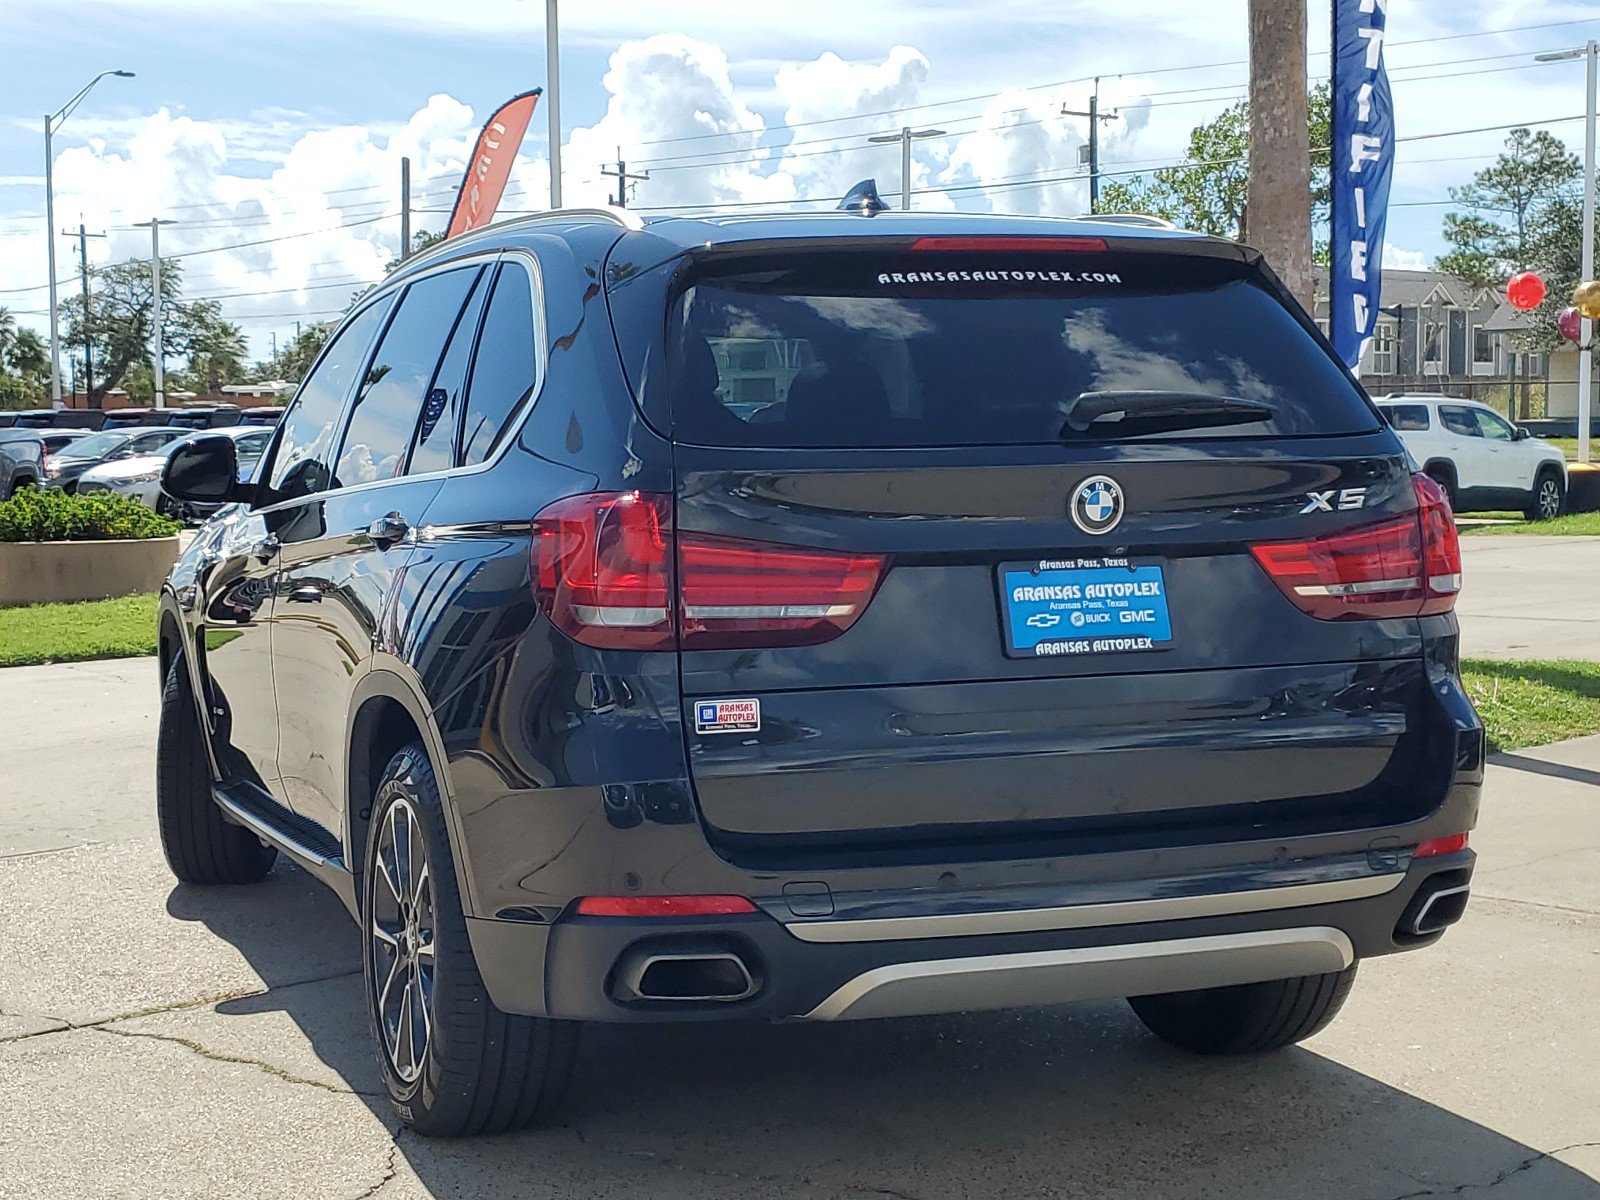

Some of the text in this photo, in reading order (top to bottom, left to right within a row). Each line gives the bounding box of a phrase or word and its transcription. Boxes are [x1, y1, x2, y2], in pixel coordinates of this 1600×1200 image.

[1350, 0, 1386, 333] TIFIED
[878, 271, 1122, 283] ARANSASAUTOPLEX.COM
[1081, 482, 1118, 498] BMW
[1299, 487, 1367, 514] X5
[1039, 557, 1128, 570] Aransas Pass, Texas
[1013, 582, 1160, 602] ARANSAS AUTOPLEX
[1049, 599, 1129, 610] Aransas Pass, Texas
[1086, 613, 1111, 622] BUICK
[1119, 610, 1155, 622] GMC
[1035, 637, 1153, 656] ARANSAS AUTOPLEX
[719, 704, 753, 713] ARANSAS
[718, 713, 755, 722] AUTOPLEX
